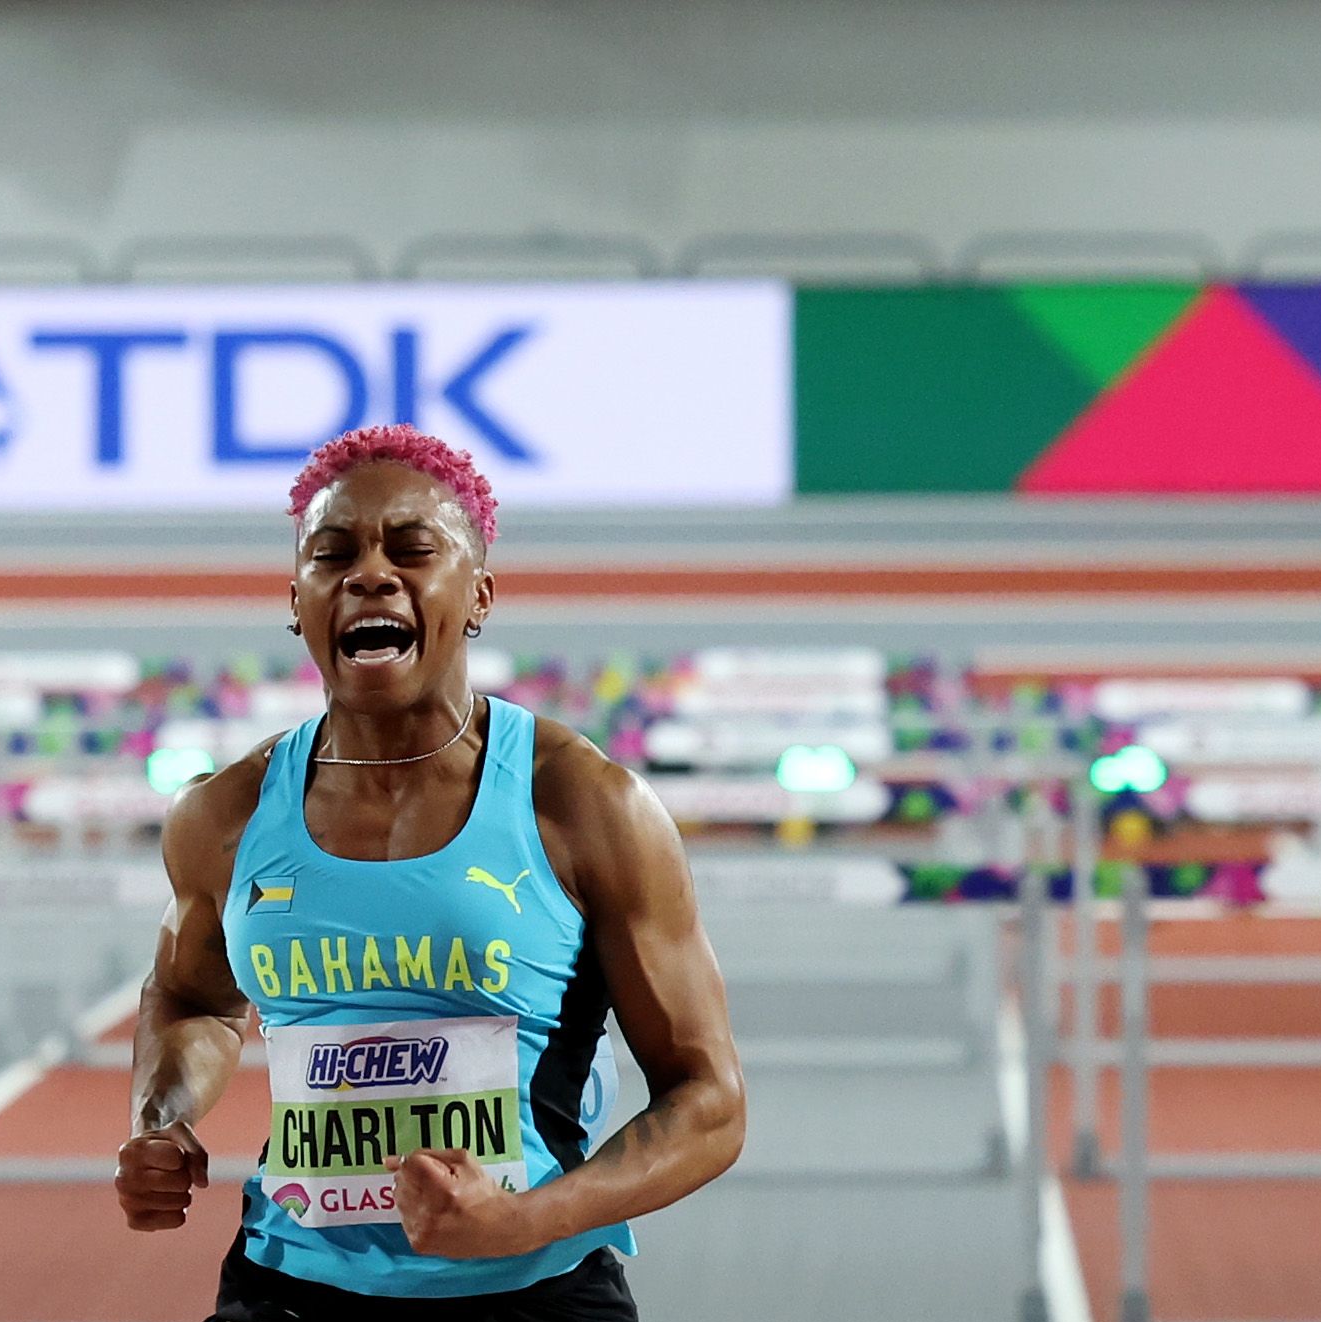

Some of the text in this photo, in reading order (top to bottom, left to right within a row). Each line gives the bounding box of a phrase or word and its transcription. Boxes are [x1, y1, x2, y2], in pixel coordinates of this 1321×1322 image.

[27, 322, 541, 466] TDK
[250, 935, 511, 998] BAHAMAS
[306, 1038, 448, 1090] HI-CHEW
